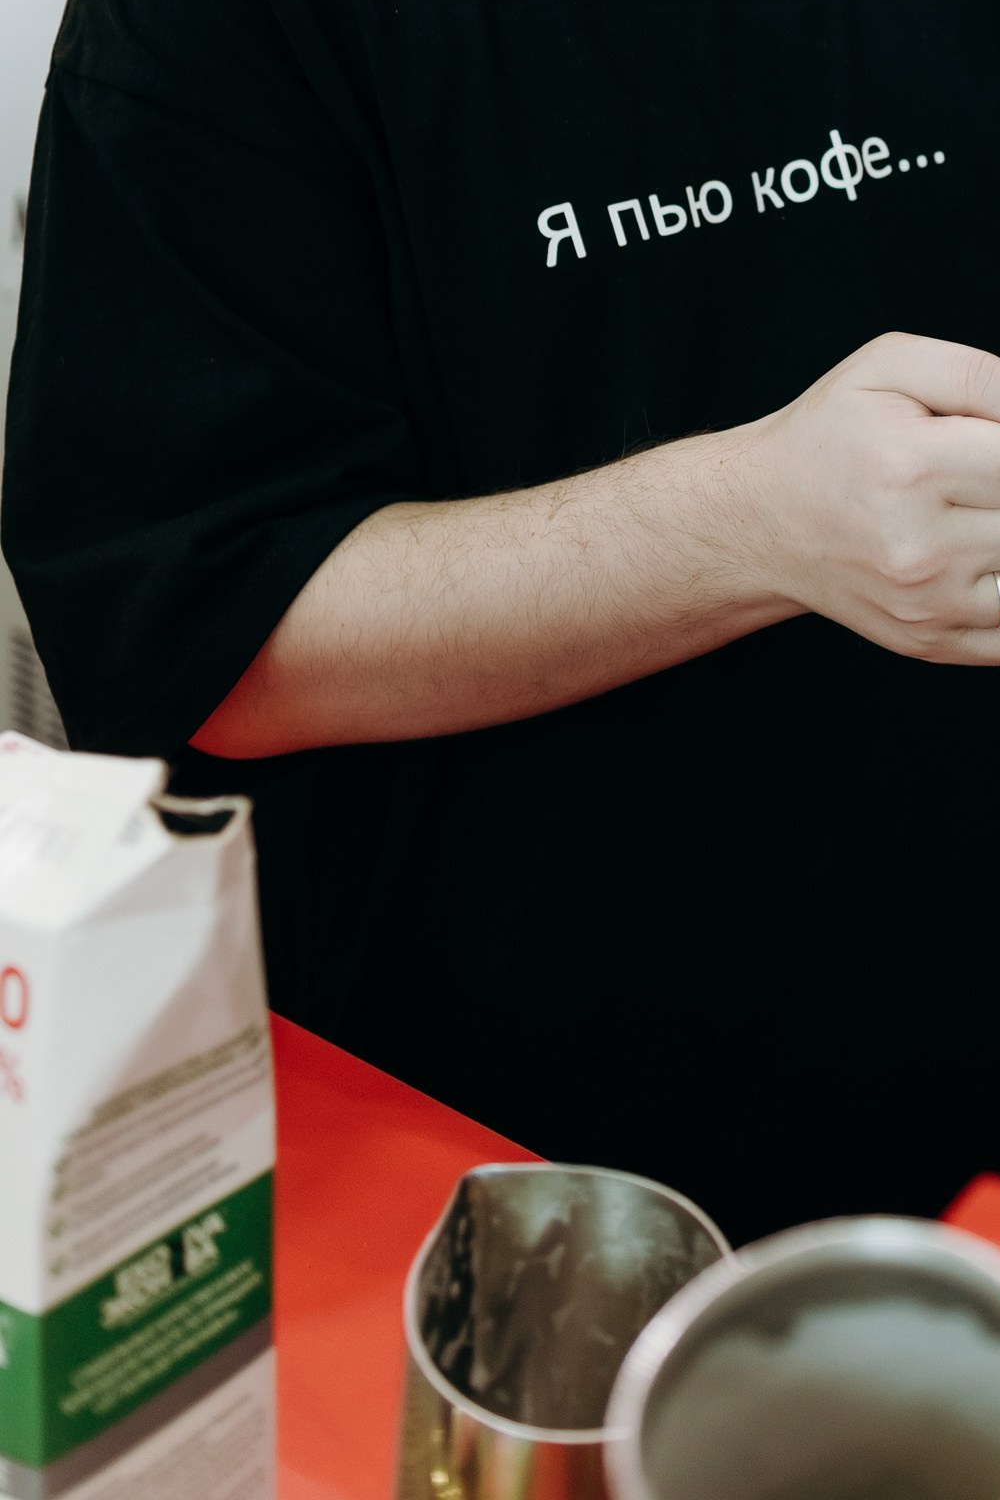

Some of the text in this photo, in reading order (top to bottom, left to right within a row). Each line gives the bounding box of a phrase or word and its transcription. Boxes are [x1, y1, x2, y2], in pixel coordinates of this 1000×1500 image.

[537, 129, 945, 268] Я пью кофе...
